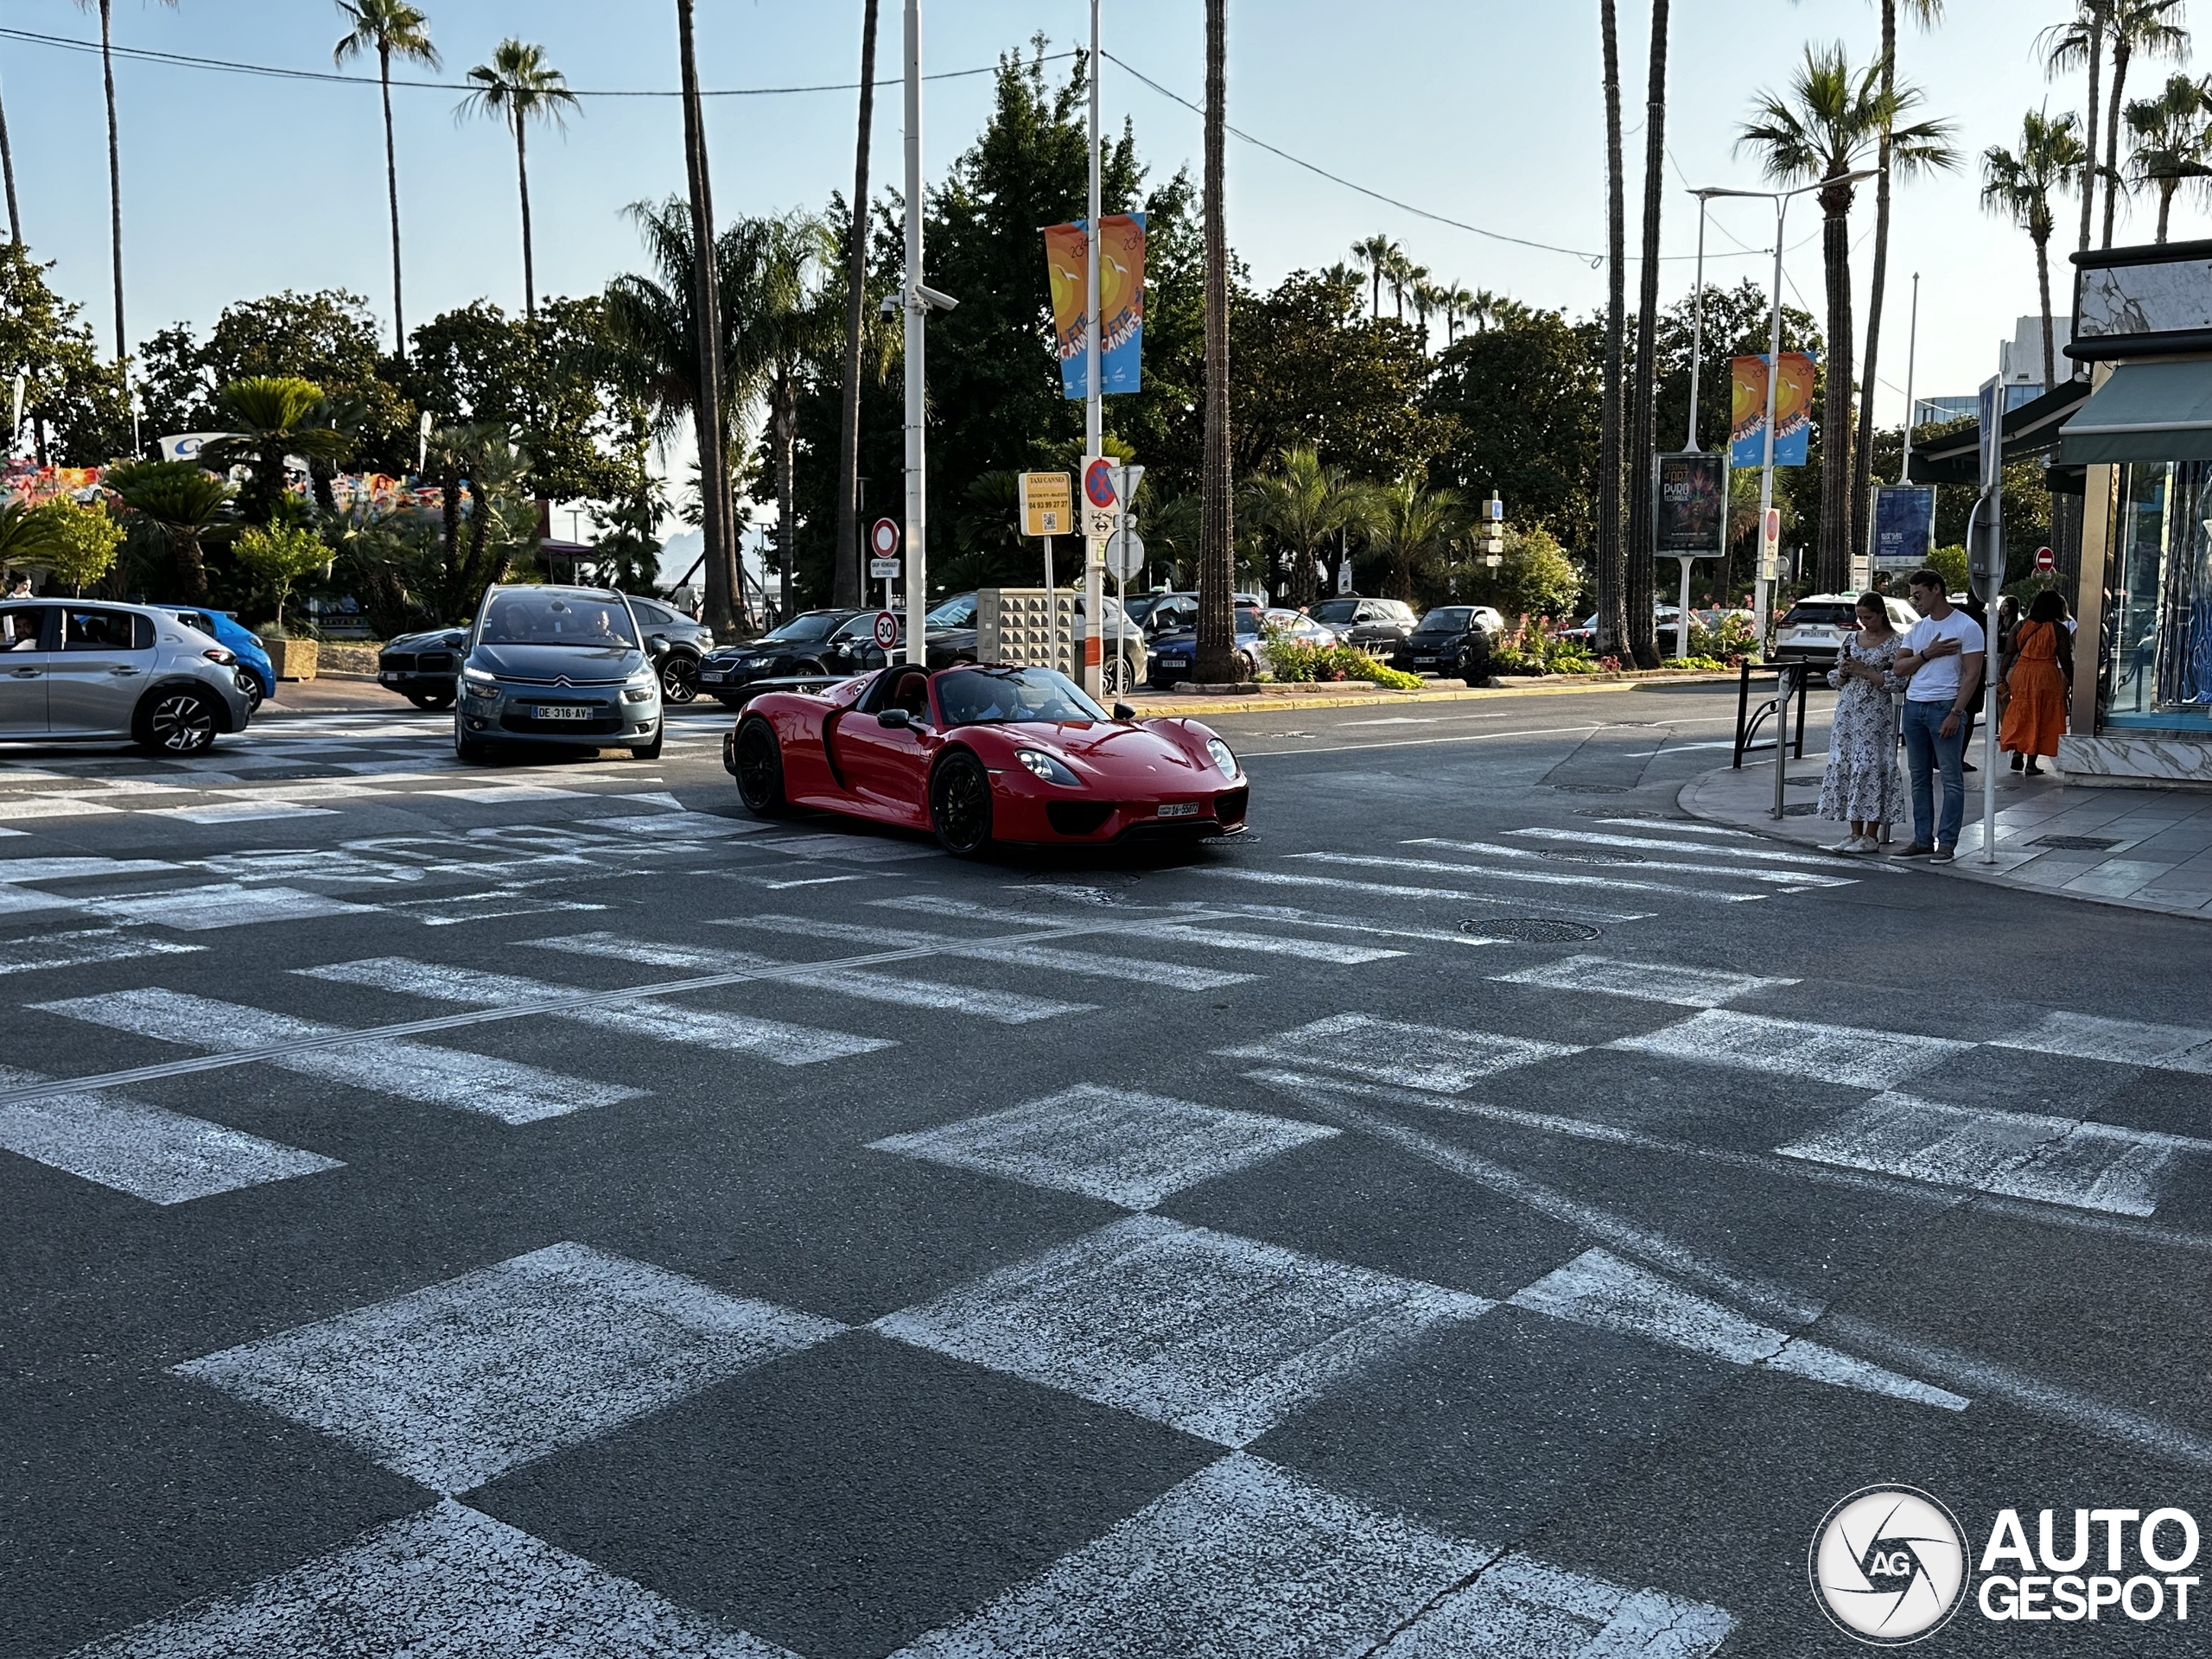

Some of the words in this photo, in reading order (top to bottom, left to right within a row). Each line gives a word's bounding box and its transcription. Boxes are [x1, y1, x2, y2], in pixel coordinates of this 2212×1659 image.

[1123, 231, 1143, 251] 2024
[1101, 311, 1141, 355] CANNES
[1774, 414, 1810, 440] CANNES
[1663, 482, 1689, 496] PYRO
[879, 622, 893, 638] 30
